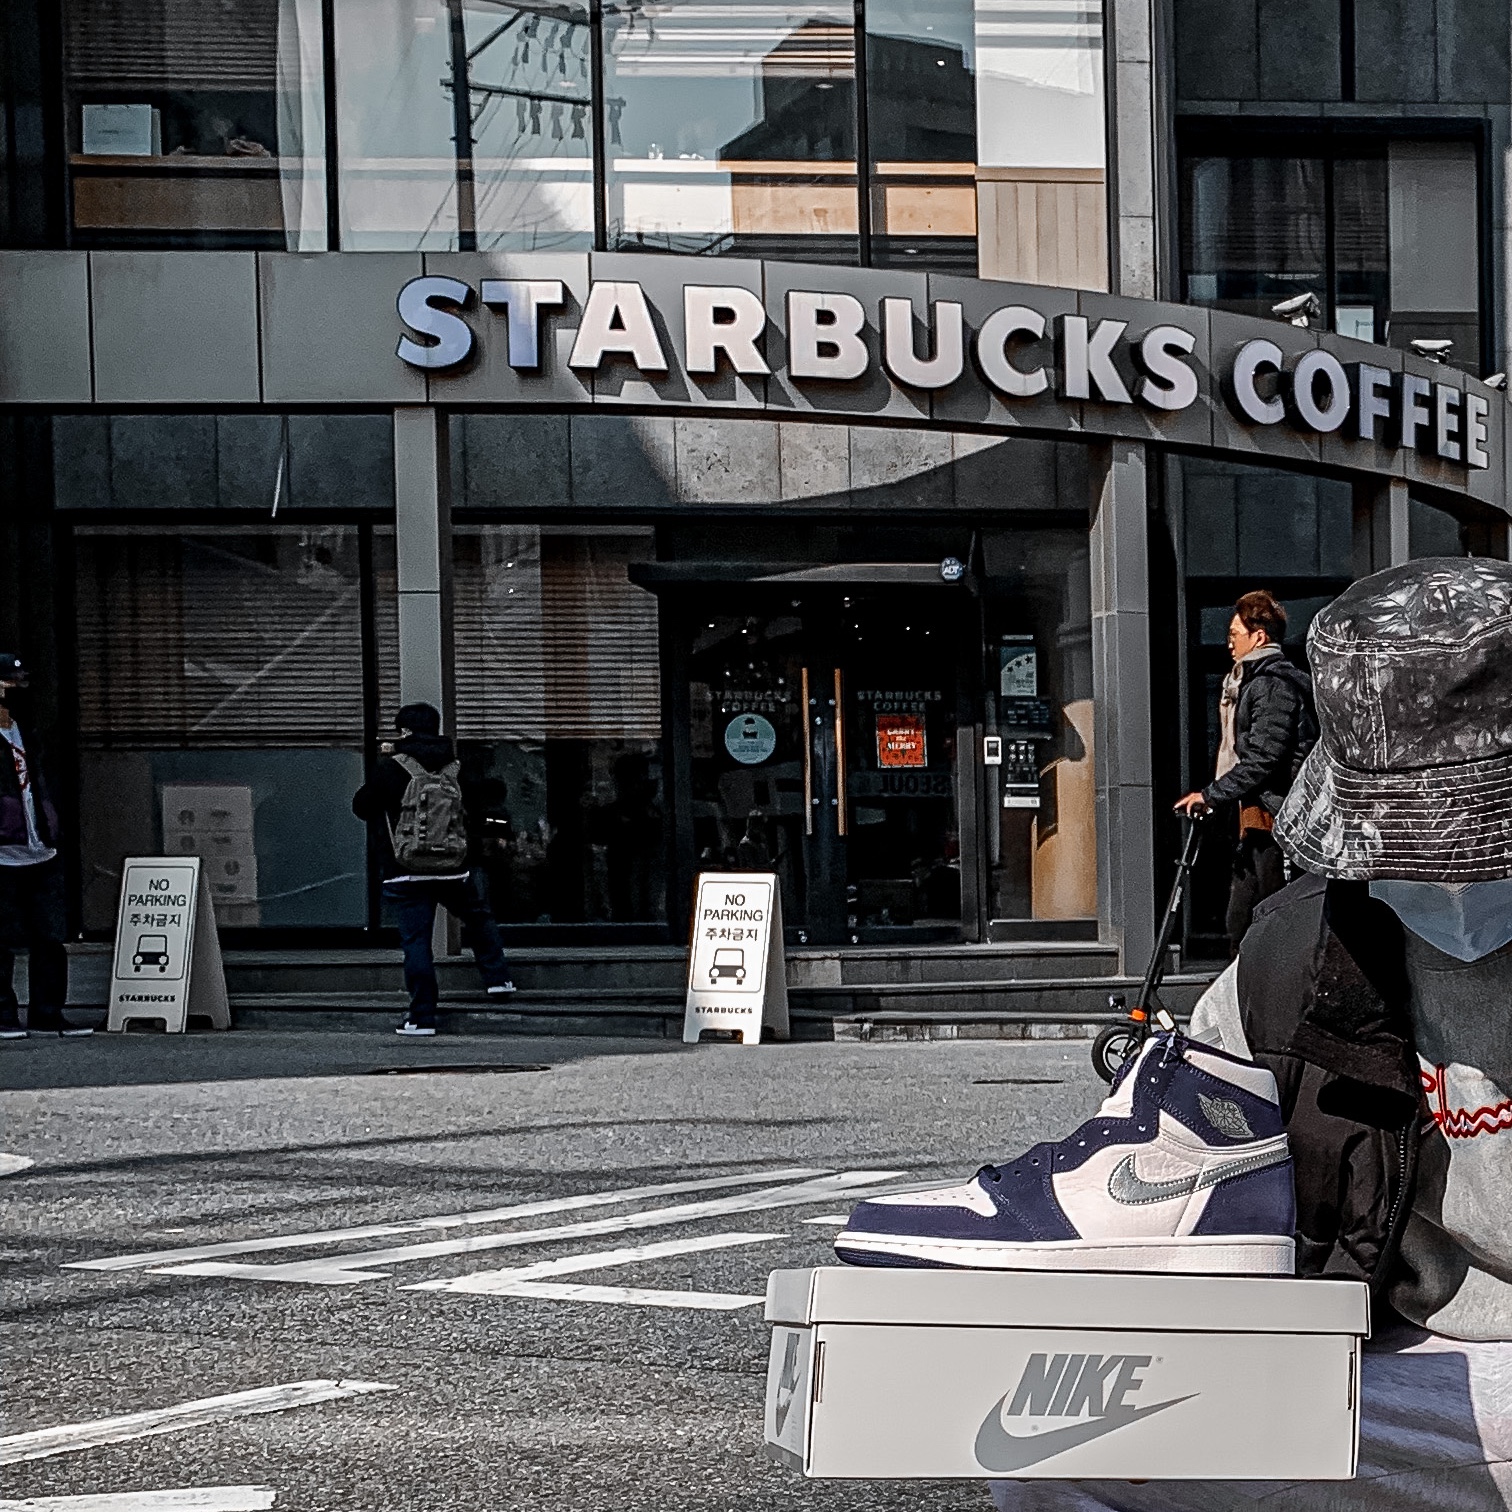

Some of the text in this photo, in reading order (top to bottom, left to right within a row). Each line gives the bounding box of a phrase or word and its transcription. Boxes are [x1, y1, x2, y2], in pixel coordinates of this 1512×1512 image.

[395, 275, 1489, 470] STARBUCKS COFFEE
[148, 878, 170, 892] NO
[127, 894, 187, 907] PARKING
[724, 893, 746, 907] NO
[129, 913, 182, 928] 주차금지
[703, 908, 764, 922] PARKING
[705, 927, 759, 942] 주차금지
[118, 993, 176, 1002] STARBUCKS
[694, 1006, 753, 1015] STARBUCKS
[1006, 1352, 1152, 1418] NIKE
